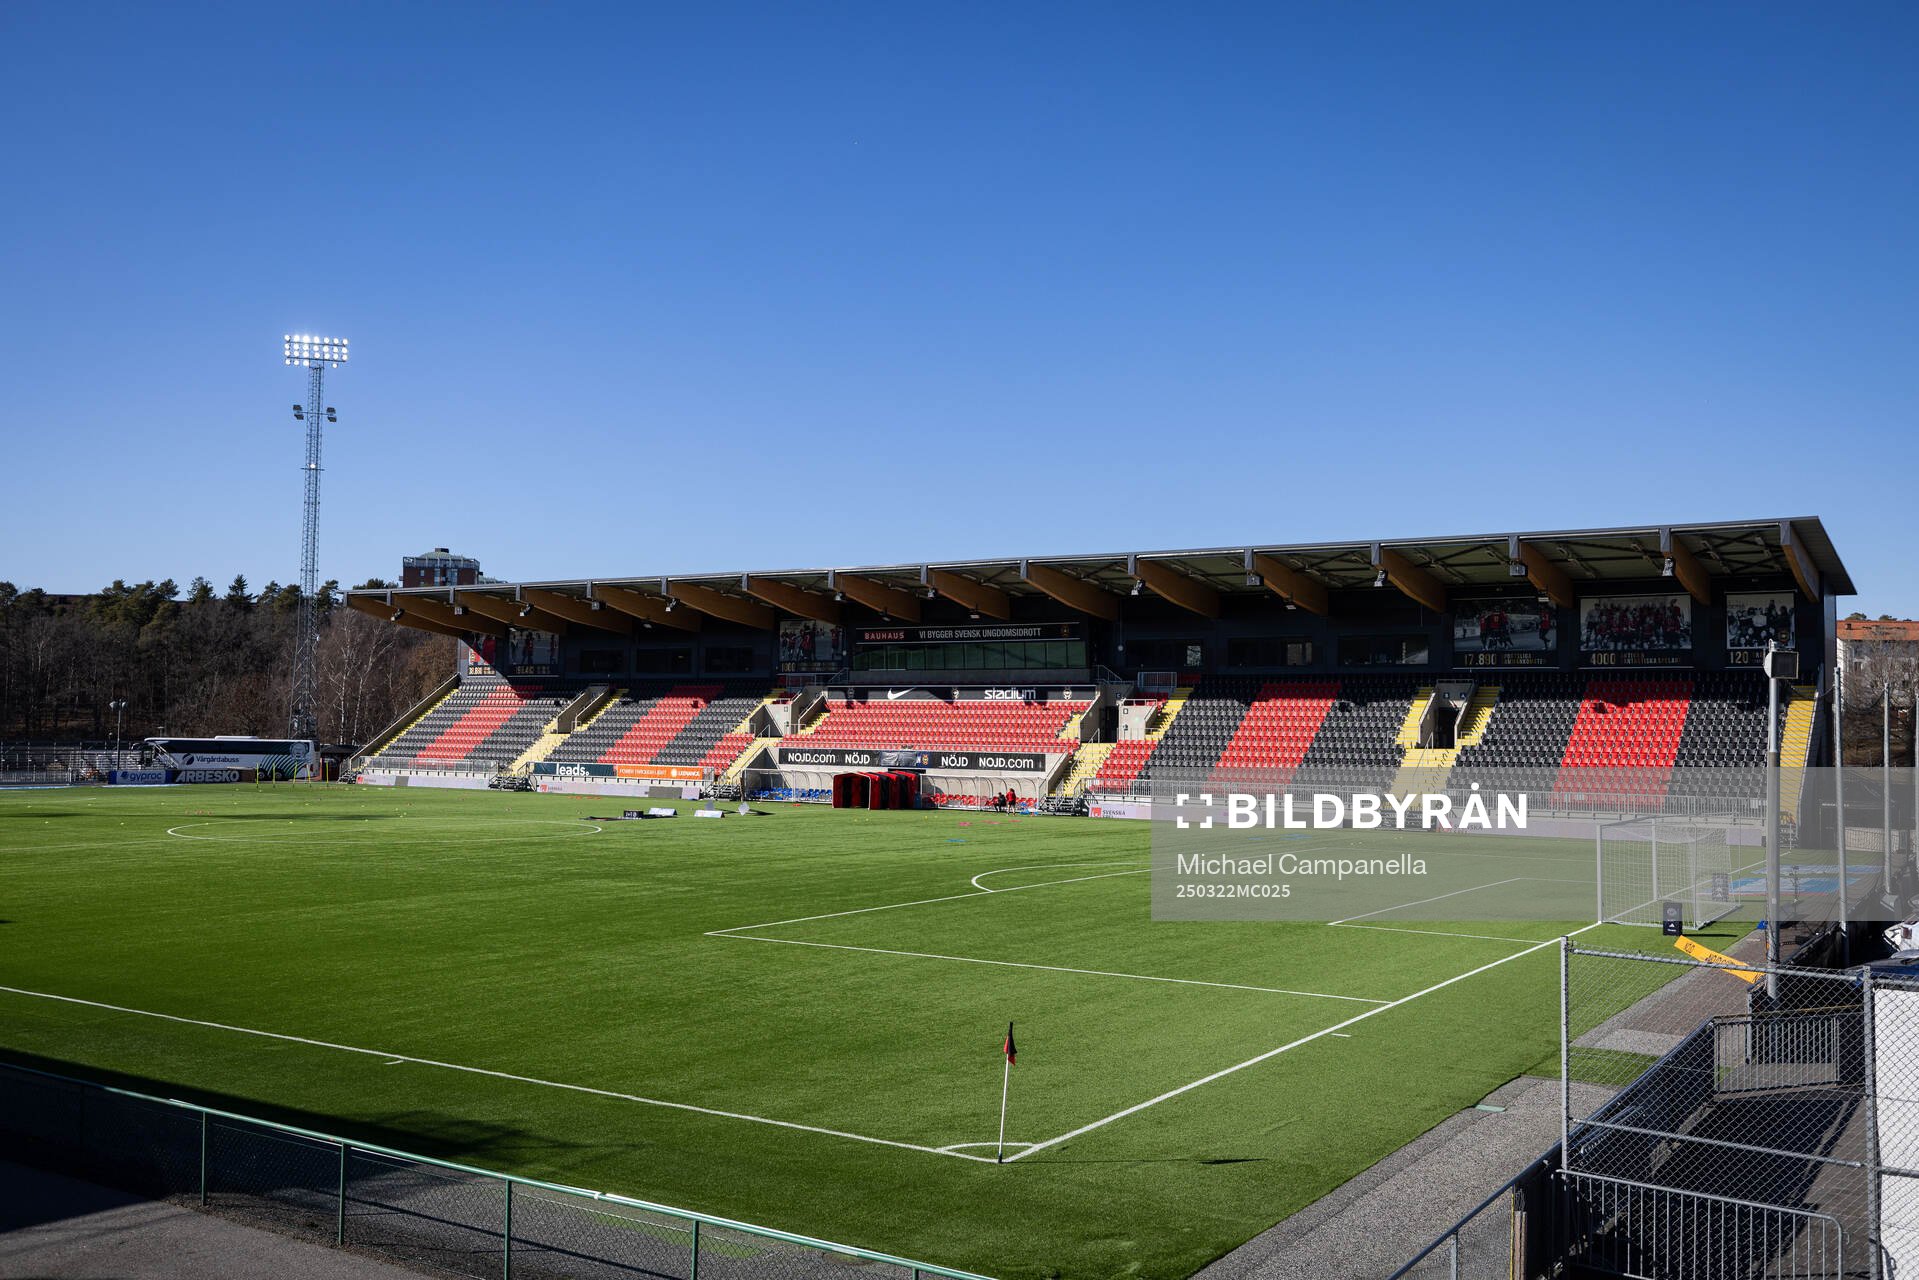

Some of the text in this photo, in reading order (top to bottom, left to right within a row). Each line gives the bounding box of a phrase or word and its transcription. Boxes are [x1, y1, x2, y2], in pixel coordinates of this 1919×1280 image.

[864, 632, 905, 640] BAUHAUS
[919, 628, 1042, 639] VI BYGGER SVENSK UNGDOMSIDROTT
[1590, 652, 1617, 665] 4000
[1730, 651, 1749, 664] 120
[984, 687, 1036, 700] stadium
[787, 752, 870, 765] NOJD.com NÖJD
[941, 754, 1034, 769] NÖJD NOJD.com
[130, 772, 162, 782] gyproc
[175, 770, 240, 784] ARBESKO
